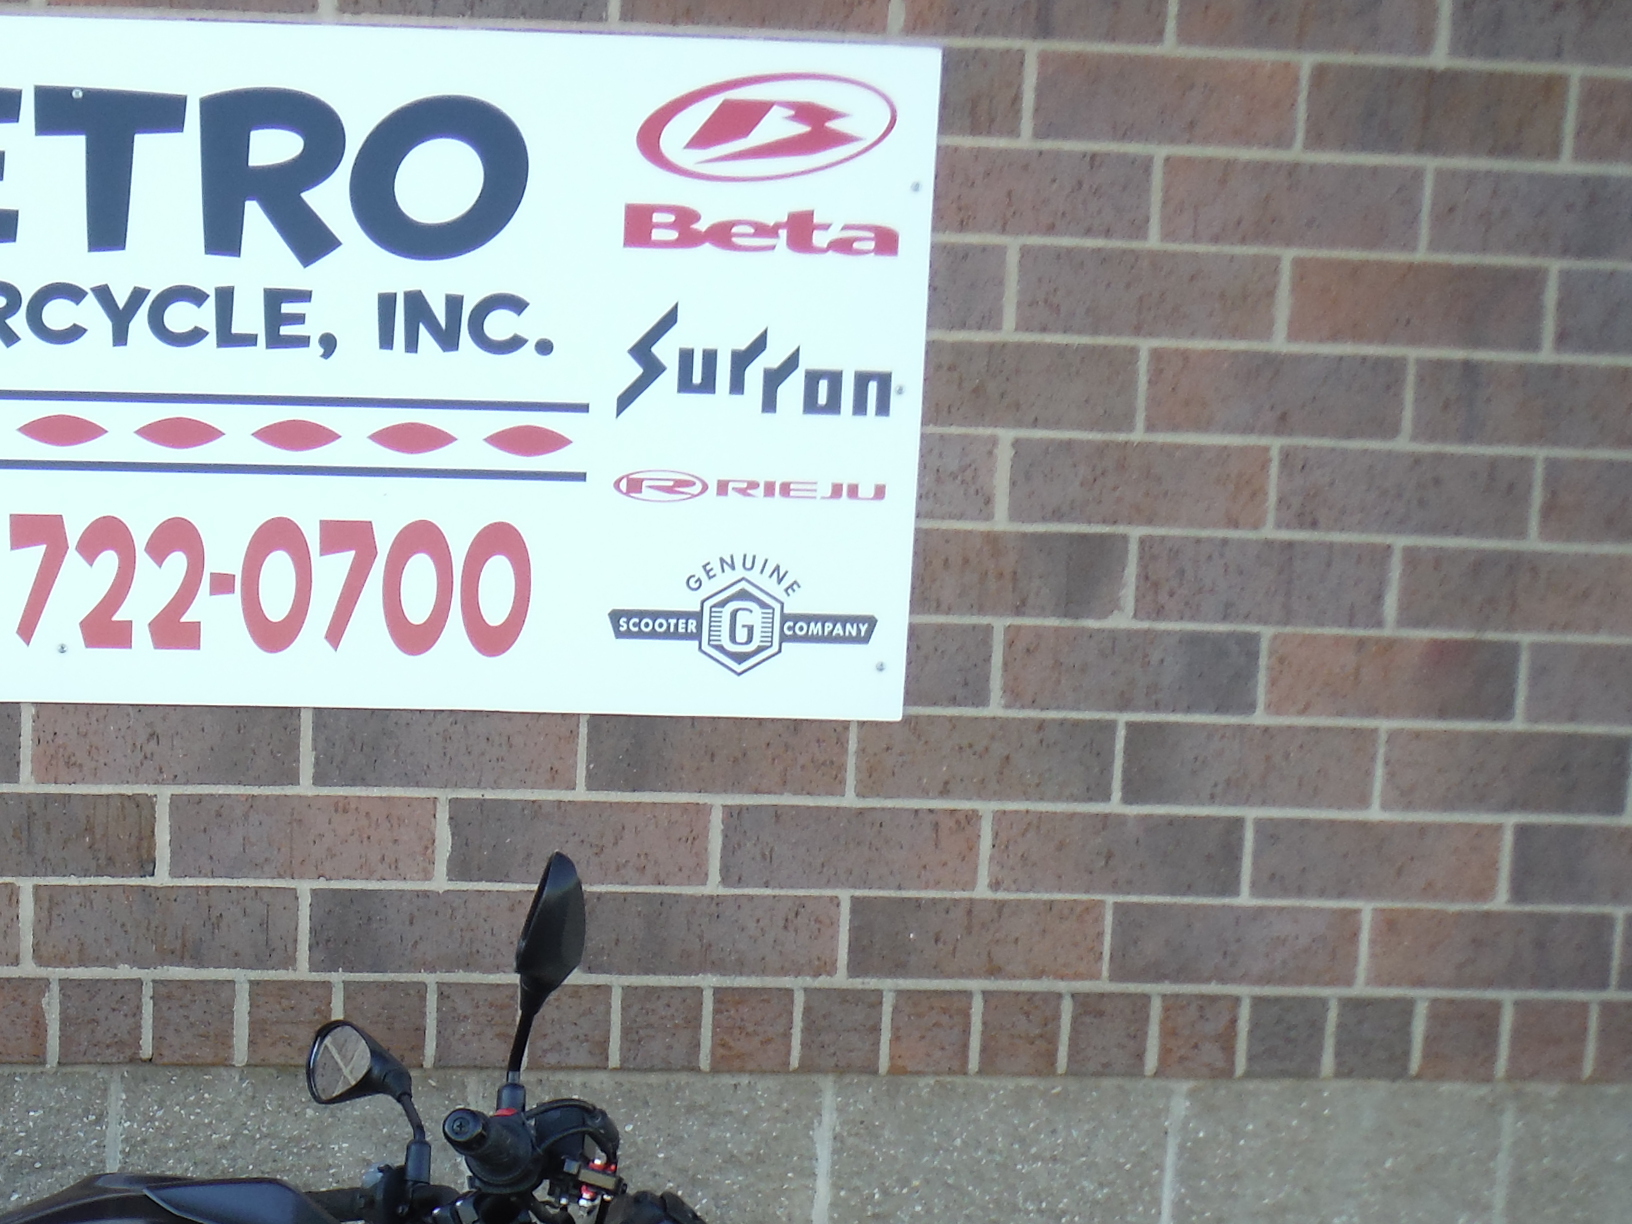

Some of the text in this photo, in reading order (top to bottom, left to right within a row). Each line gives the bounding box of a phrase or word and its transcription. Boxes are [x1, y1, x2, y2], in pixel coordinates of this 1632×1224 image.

[622, 203, 900, 257] Beta
[377, 289, 555, 357] INC.
[615, 301, 893, 420] Surron
[716, 478, 886, 501] RIEJU
[9, 513, 532, 658] 722-0700
[685, 553, 802, 598] GENUINE
[618, 616, 869, 638] SCOOTER COMPANY
[728, 606, 756, 646] G
